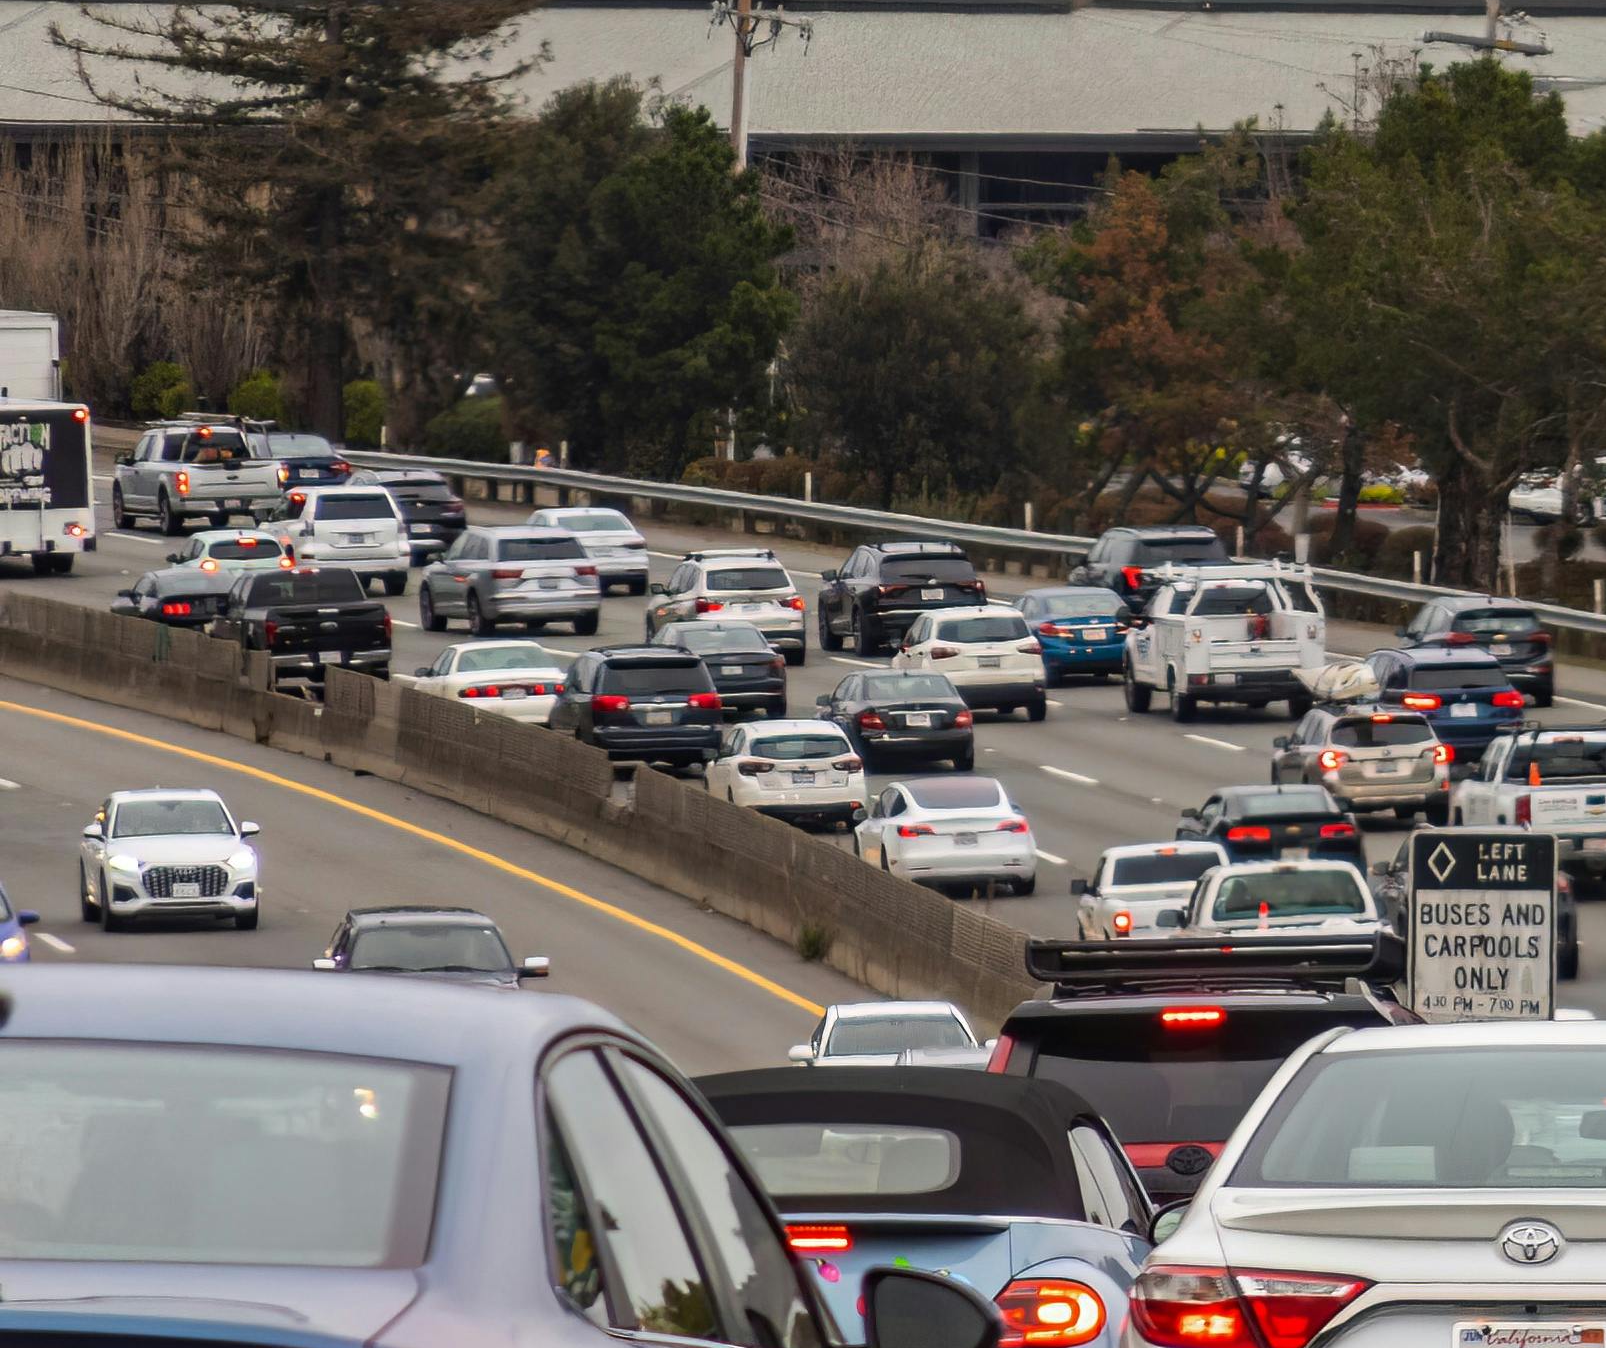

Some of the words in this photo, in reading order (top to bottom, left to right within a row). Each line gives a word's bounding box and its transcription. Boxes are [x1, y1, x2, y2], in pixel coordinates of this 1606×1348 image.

[1479, 843, 1526, 861] LEFT
[1477, 864, 1528, 882] LANE
[1420, 903, 1490, 926] BUSES
[1502, 904, 1545, 926] AND
[1424, 934, 1540, 958] CARPOOLS
[1454, 966, 1509, 990] ONLY
[1453, 997, 1473, 1011] PM
[1520, 999, 1540, 1014] PM
